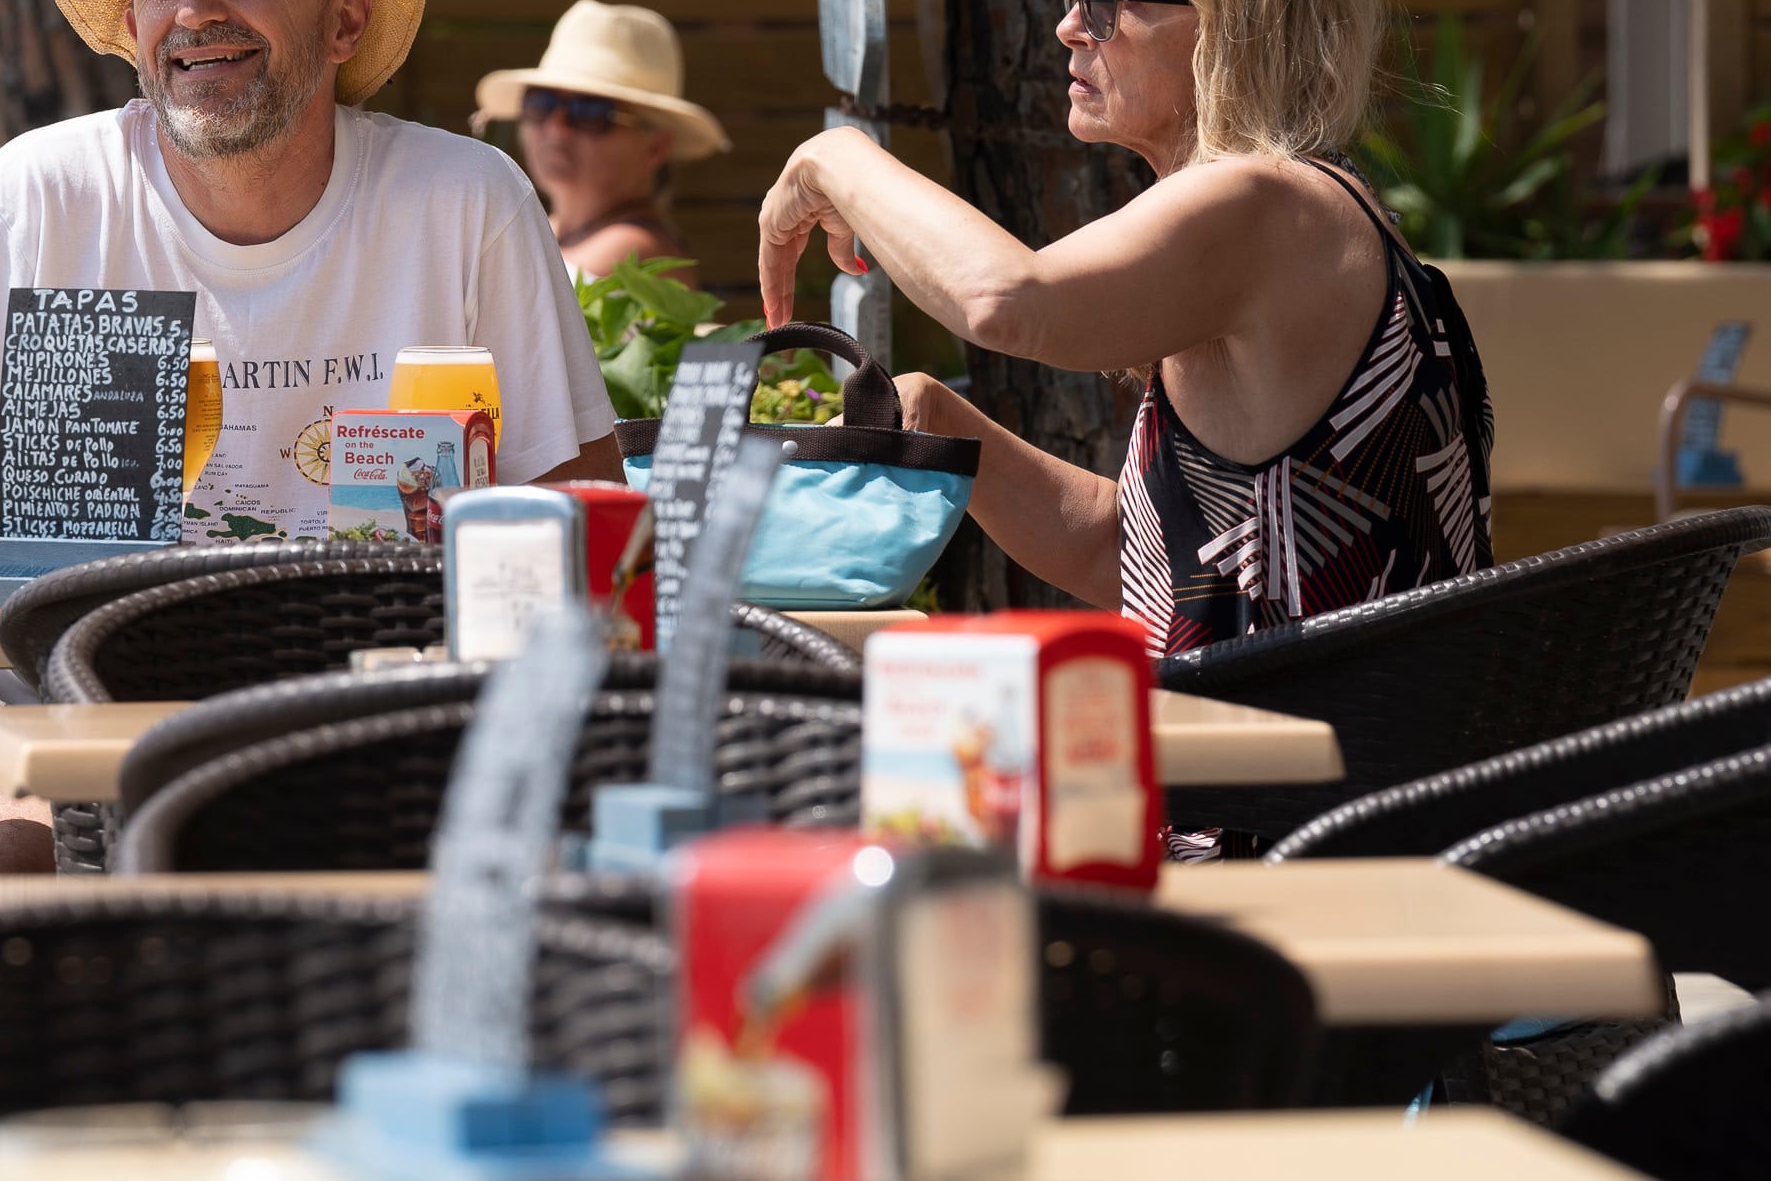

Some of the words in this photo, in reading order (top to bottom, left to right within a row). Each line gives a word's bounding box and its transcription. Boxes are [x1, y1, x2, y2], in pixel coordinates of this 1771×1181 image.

[33, 289, 138, 313] TAPAS
[12, 312, 93, 335] PATATAS
[99, 315, 164, 336] BRAVAS
[6, 334, 103, 352] CROQUETAS
[107, 337, 175, 355] CASERAS
[6, 351, 109, 368] CHIPIRONES
[157, 356, 189, 370] 6.50
[7, 365, 112, 385] MEJILLONES
[156, 371, 186, 387] 6.50
[221, 359, 312, 389] ARTIN
[324, 353, 384, 385] F.W.I.
[2, 382, 93, 403] CALAMARES
[93, 390, 144, 402] ANDALUZA
[156, 389, 186, 404] 6.50
[1, 400, 80, 418] ALMEJAS
[157, 405, 185, 419] 6.50
[323, 406, 334, 417] N
[1, 417, 59, 434] JAMON
[337, 425, 425, 439] Refréscate
[3, 433, 59, 450] STICKS
[155, 438, 182, 454] 6.50
[279, 447, 291, 459] W
[345, 441, 357, 449] on
[360, 441, 374, 449] the
[62, 457, 77, 467] DE
[155, 454, 182, 471] 7.00
[345, 451, 394, 465] Beach
[2, 465, 48, 484] QUESO
[54, 469, 108, 484] CURADO
[87, 502, 140, 519] PADRON
[2, 516, 56, 534] STICKS
[63, 519, 139, 537] MOZZARELLA
